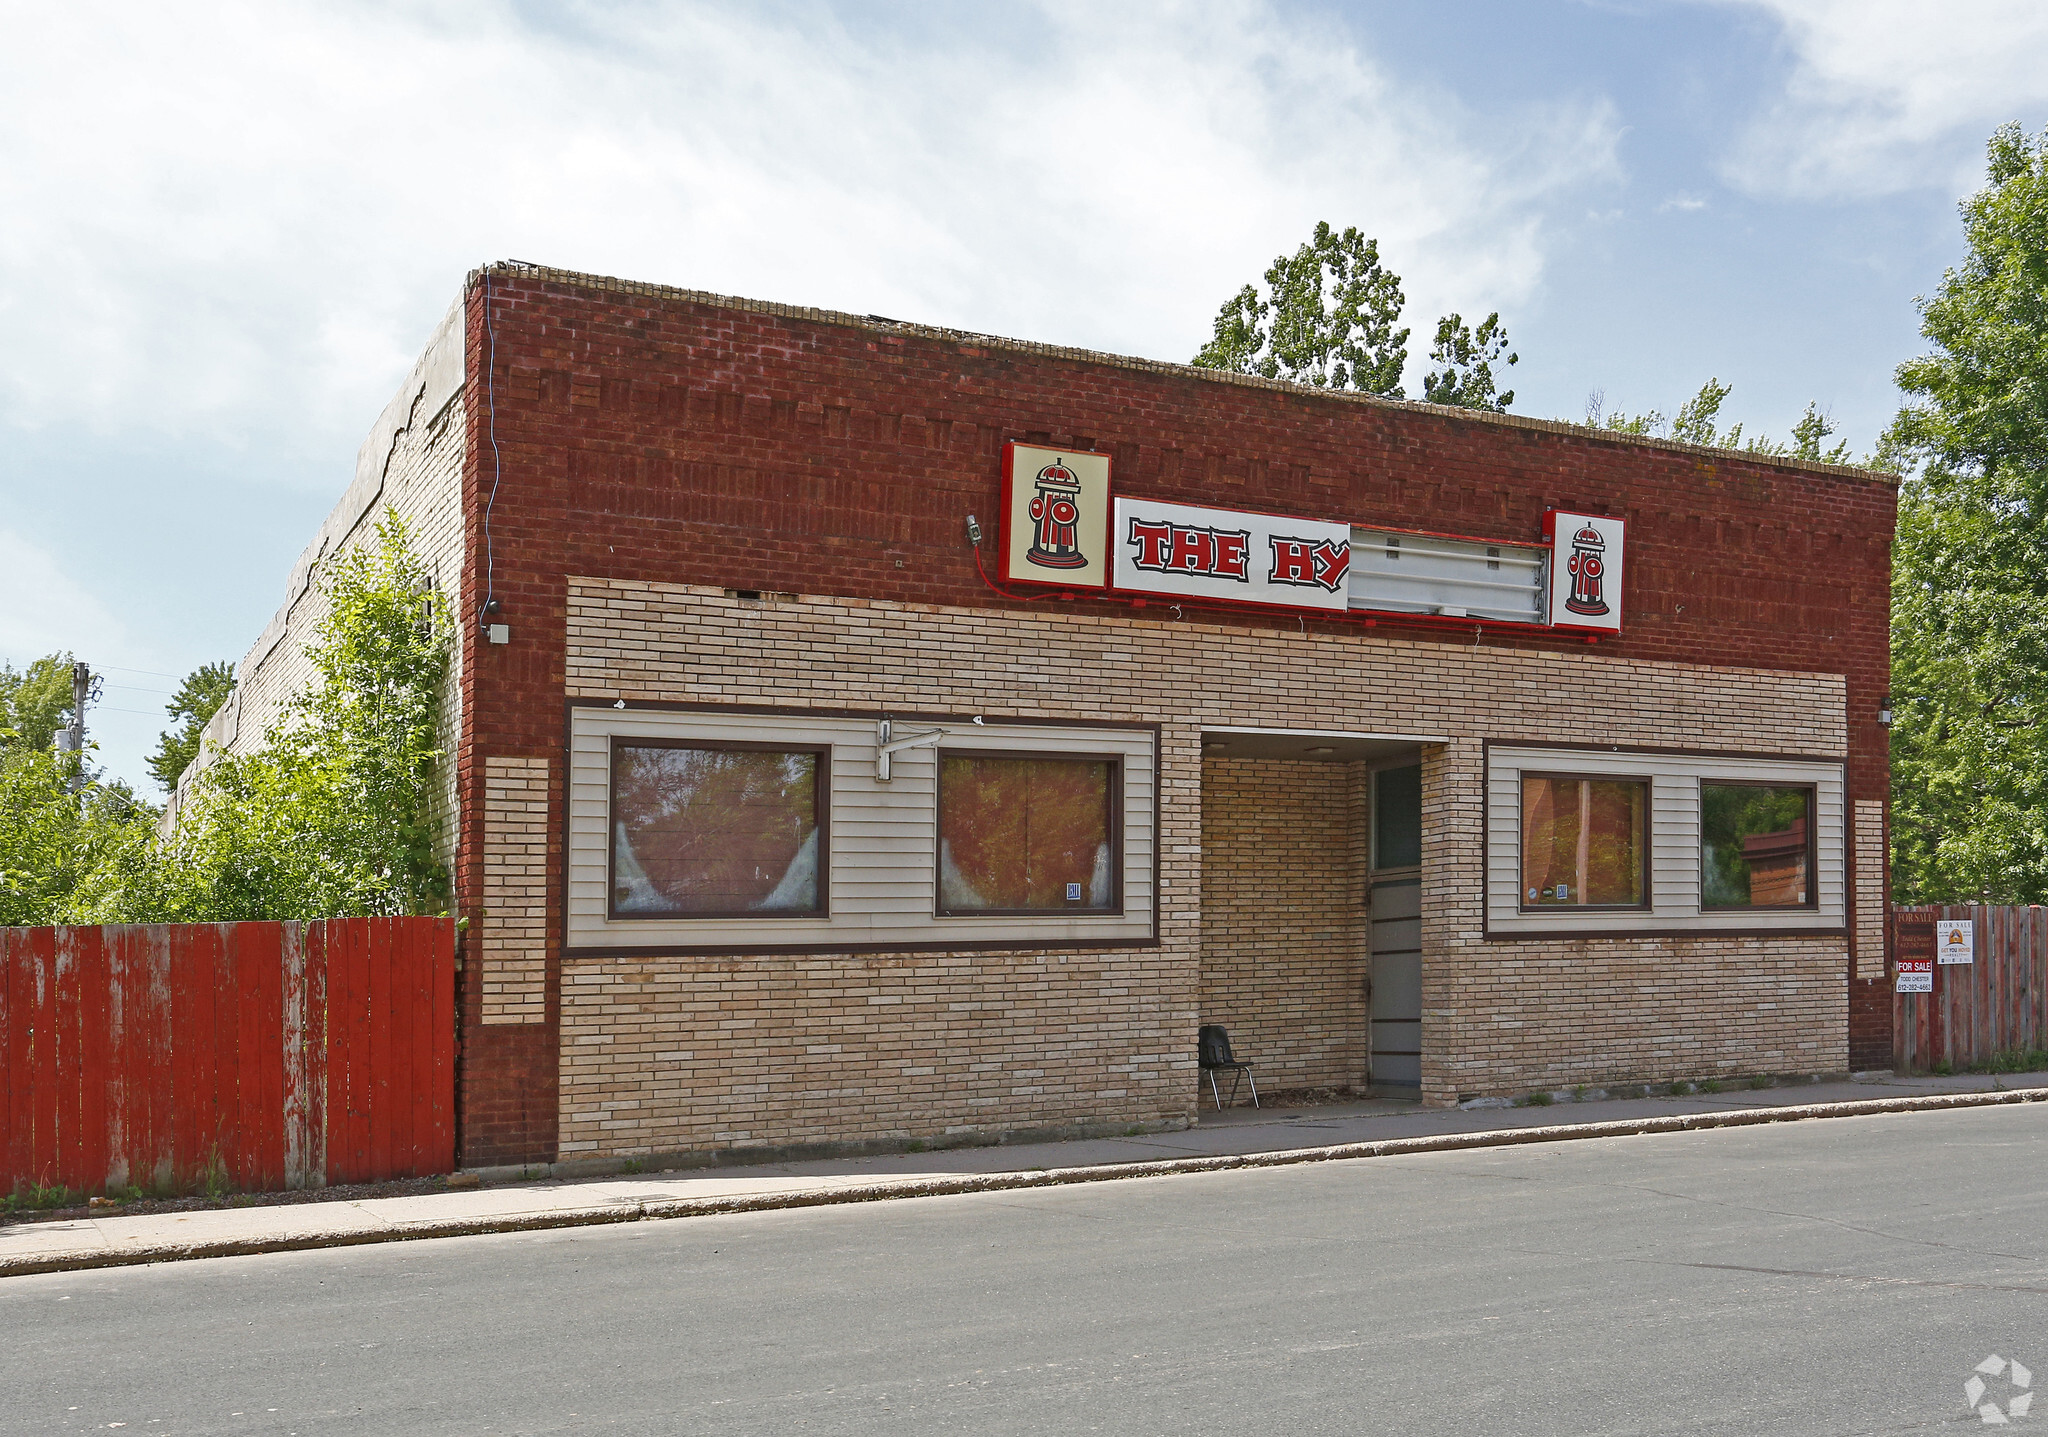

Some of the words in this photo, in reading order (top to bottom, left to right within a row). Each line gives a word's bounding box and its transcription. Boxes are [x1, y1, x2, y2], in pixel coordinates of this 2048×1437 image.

[1127, 517, 1251, 583] THE
[1268, 534, 1350, 594] HY
[1898, 913, 1915, 923] FOR
[1915, 913, 1933, 923] SALE
[1898, 962, 1912, 971] FOR
[1914, 962, 1931, 971] SALE
